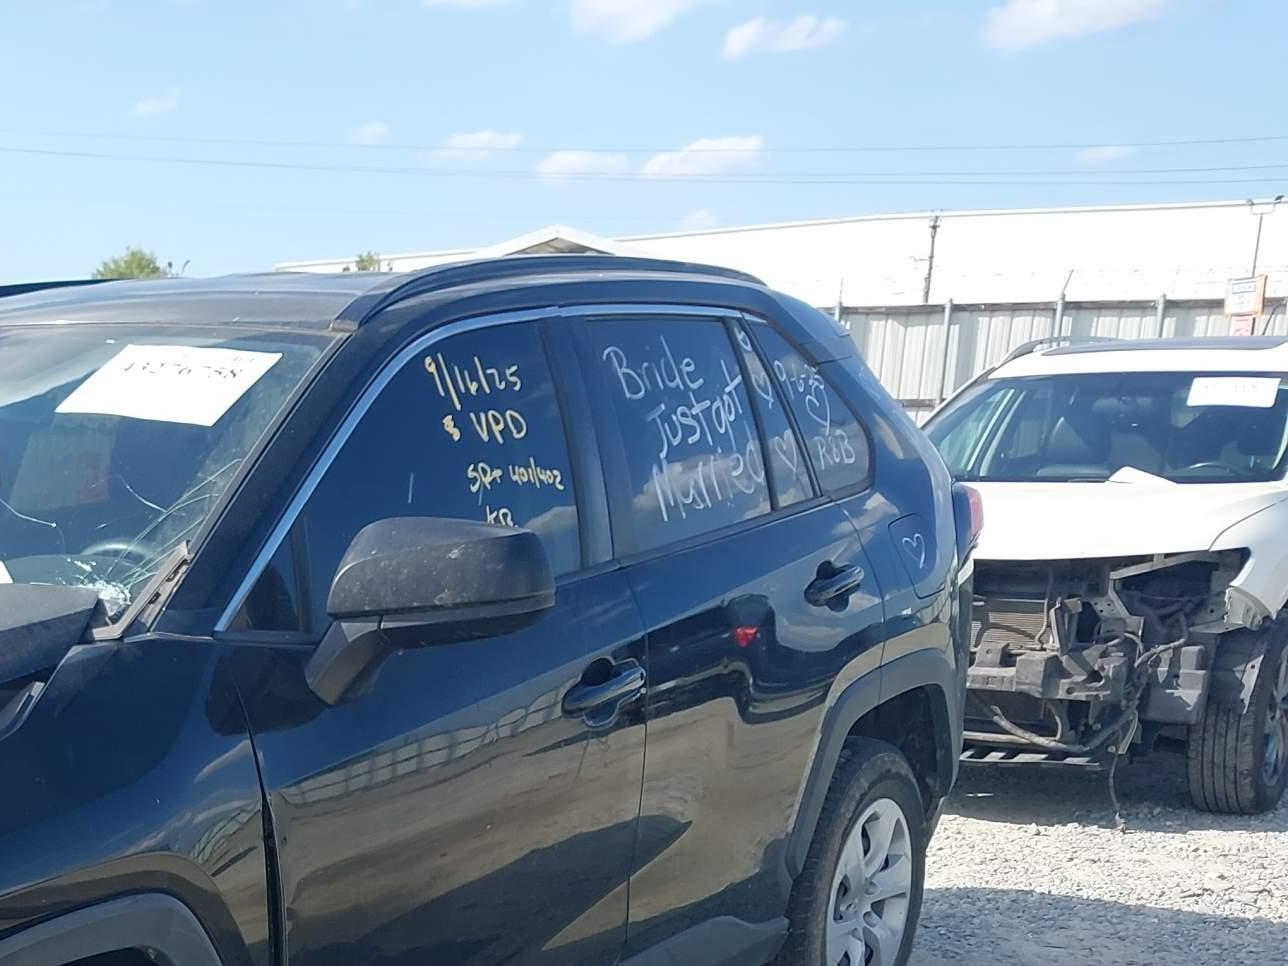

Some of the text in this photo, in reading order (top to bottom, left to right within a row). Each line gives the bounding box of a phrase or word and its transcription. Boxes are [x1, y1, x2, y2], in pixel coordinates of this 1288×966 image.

[424, 352, 521, 411] 9/16/25
[603, 336, 704, 400] Bride
[469, 410, 527, 444] VPD
